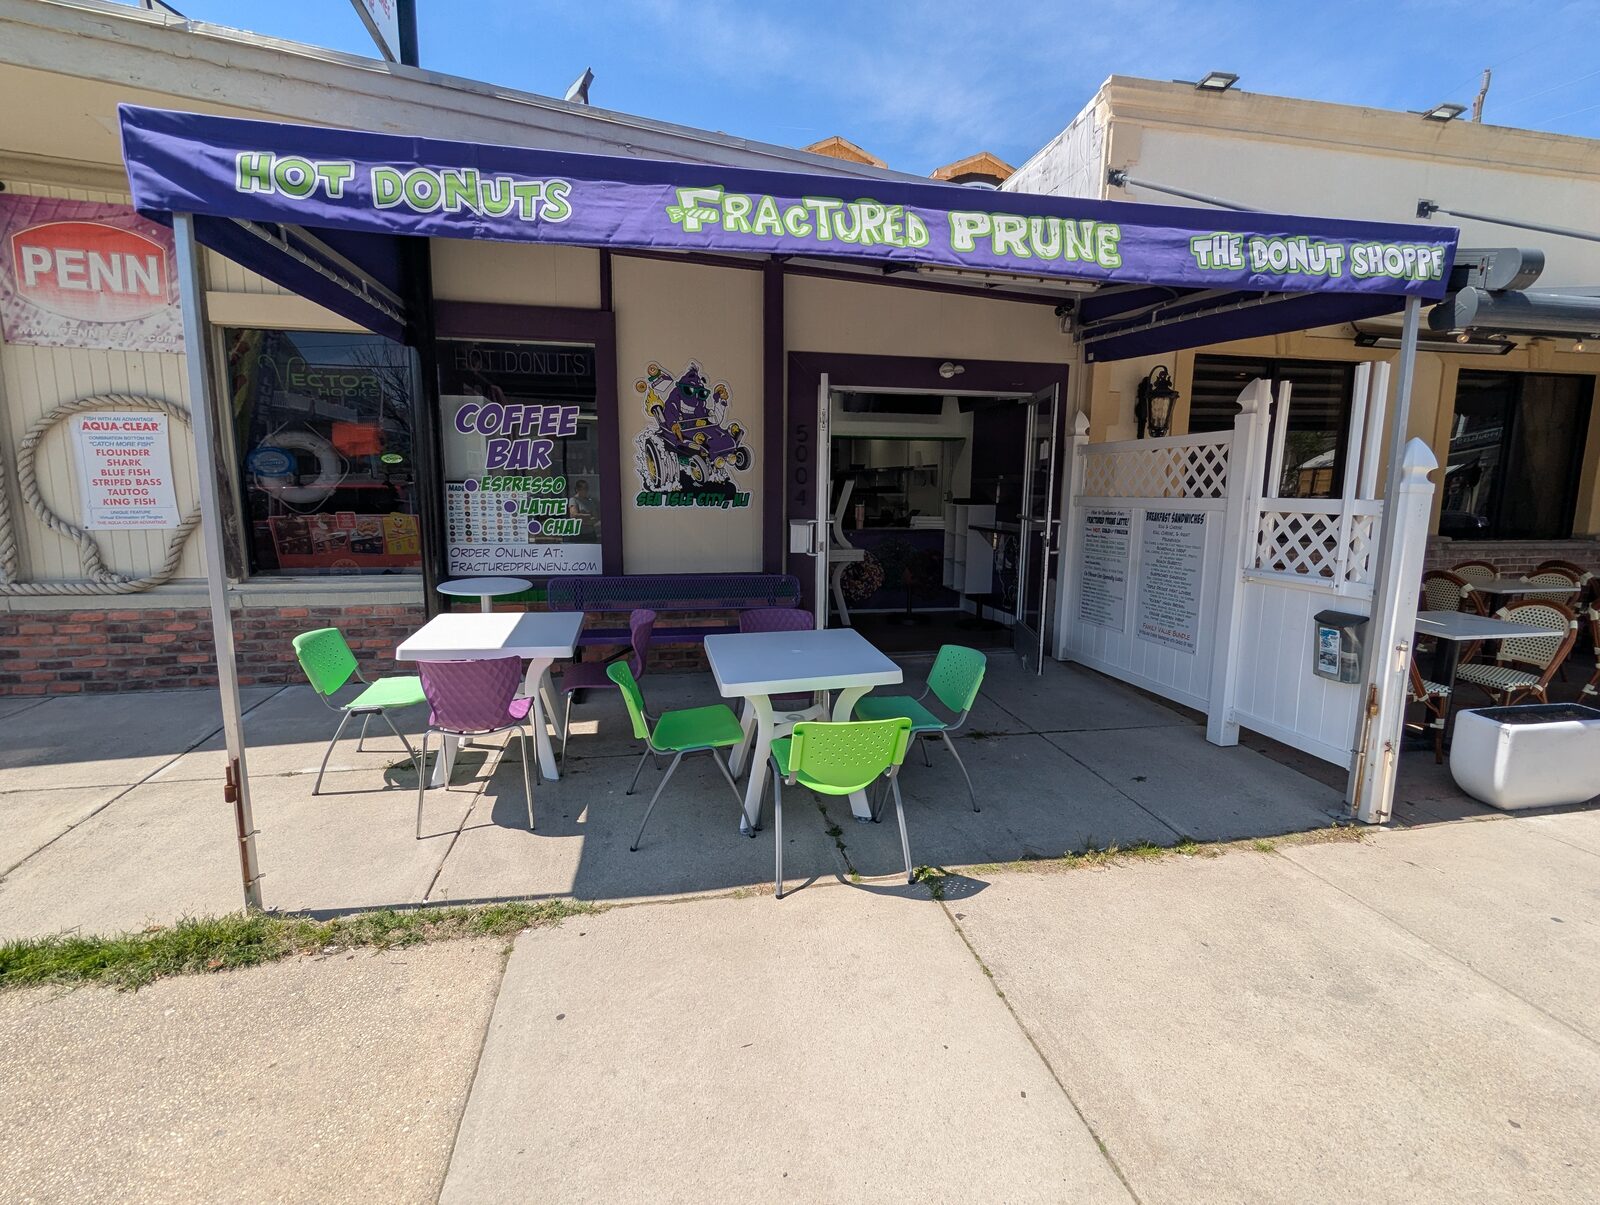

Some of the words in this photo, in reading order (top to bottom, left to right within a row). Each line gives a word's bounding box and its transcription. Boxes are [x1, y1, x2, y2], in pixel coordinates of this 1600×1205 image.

[236, 151, 355, 200] HOT
[371, 166, 572, 223] DONUTS
[666, 184, 929, 248] FRACTURED
[948, 210, 1122, 269] PRUNE
[1191, 232, 1245, 270] THE
[1251, 236, 1345, 278] DONUT
[1351, 242, 1445, 280] SHOPPE
[21, 245, 160, 295] PENN
[454, 348, 495, 372] HOT
[504, 351, 586, 375] DONUTS
[318, 388, 380, 398] HOOKS
[82, 422, 158, 431] AQUA-CLEAR
[454, 402, 580, 437] COFFEE
[485, 438, 554, 470] BAR
[480, 476, 566, 494] ESPRESSO
[518, 498, 568, 516] LATTE
[636, 492, 662, 506] SEA
[665, 492, 694, 506] ISLE
[698, 492, 730, 509] CITY,
[732, 492, 750, 506] NJ
[542, 518, 582, 536] CHAI
[1146, 512, 1171, 522] BREAKFAST
[1171, 512, 1205, 524] SANDWICHES
[450, 548, 490, 558] ORDER
[495, 548, 538, 558] ONLINE
[543, 548, 564, 558] AT:
